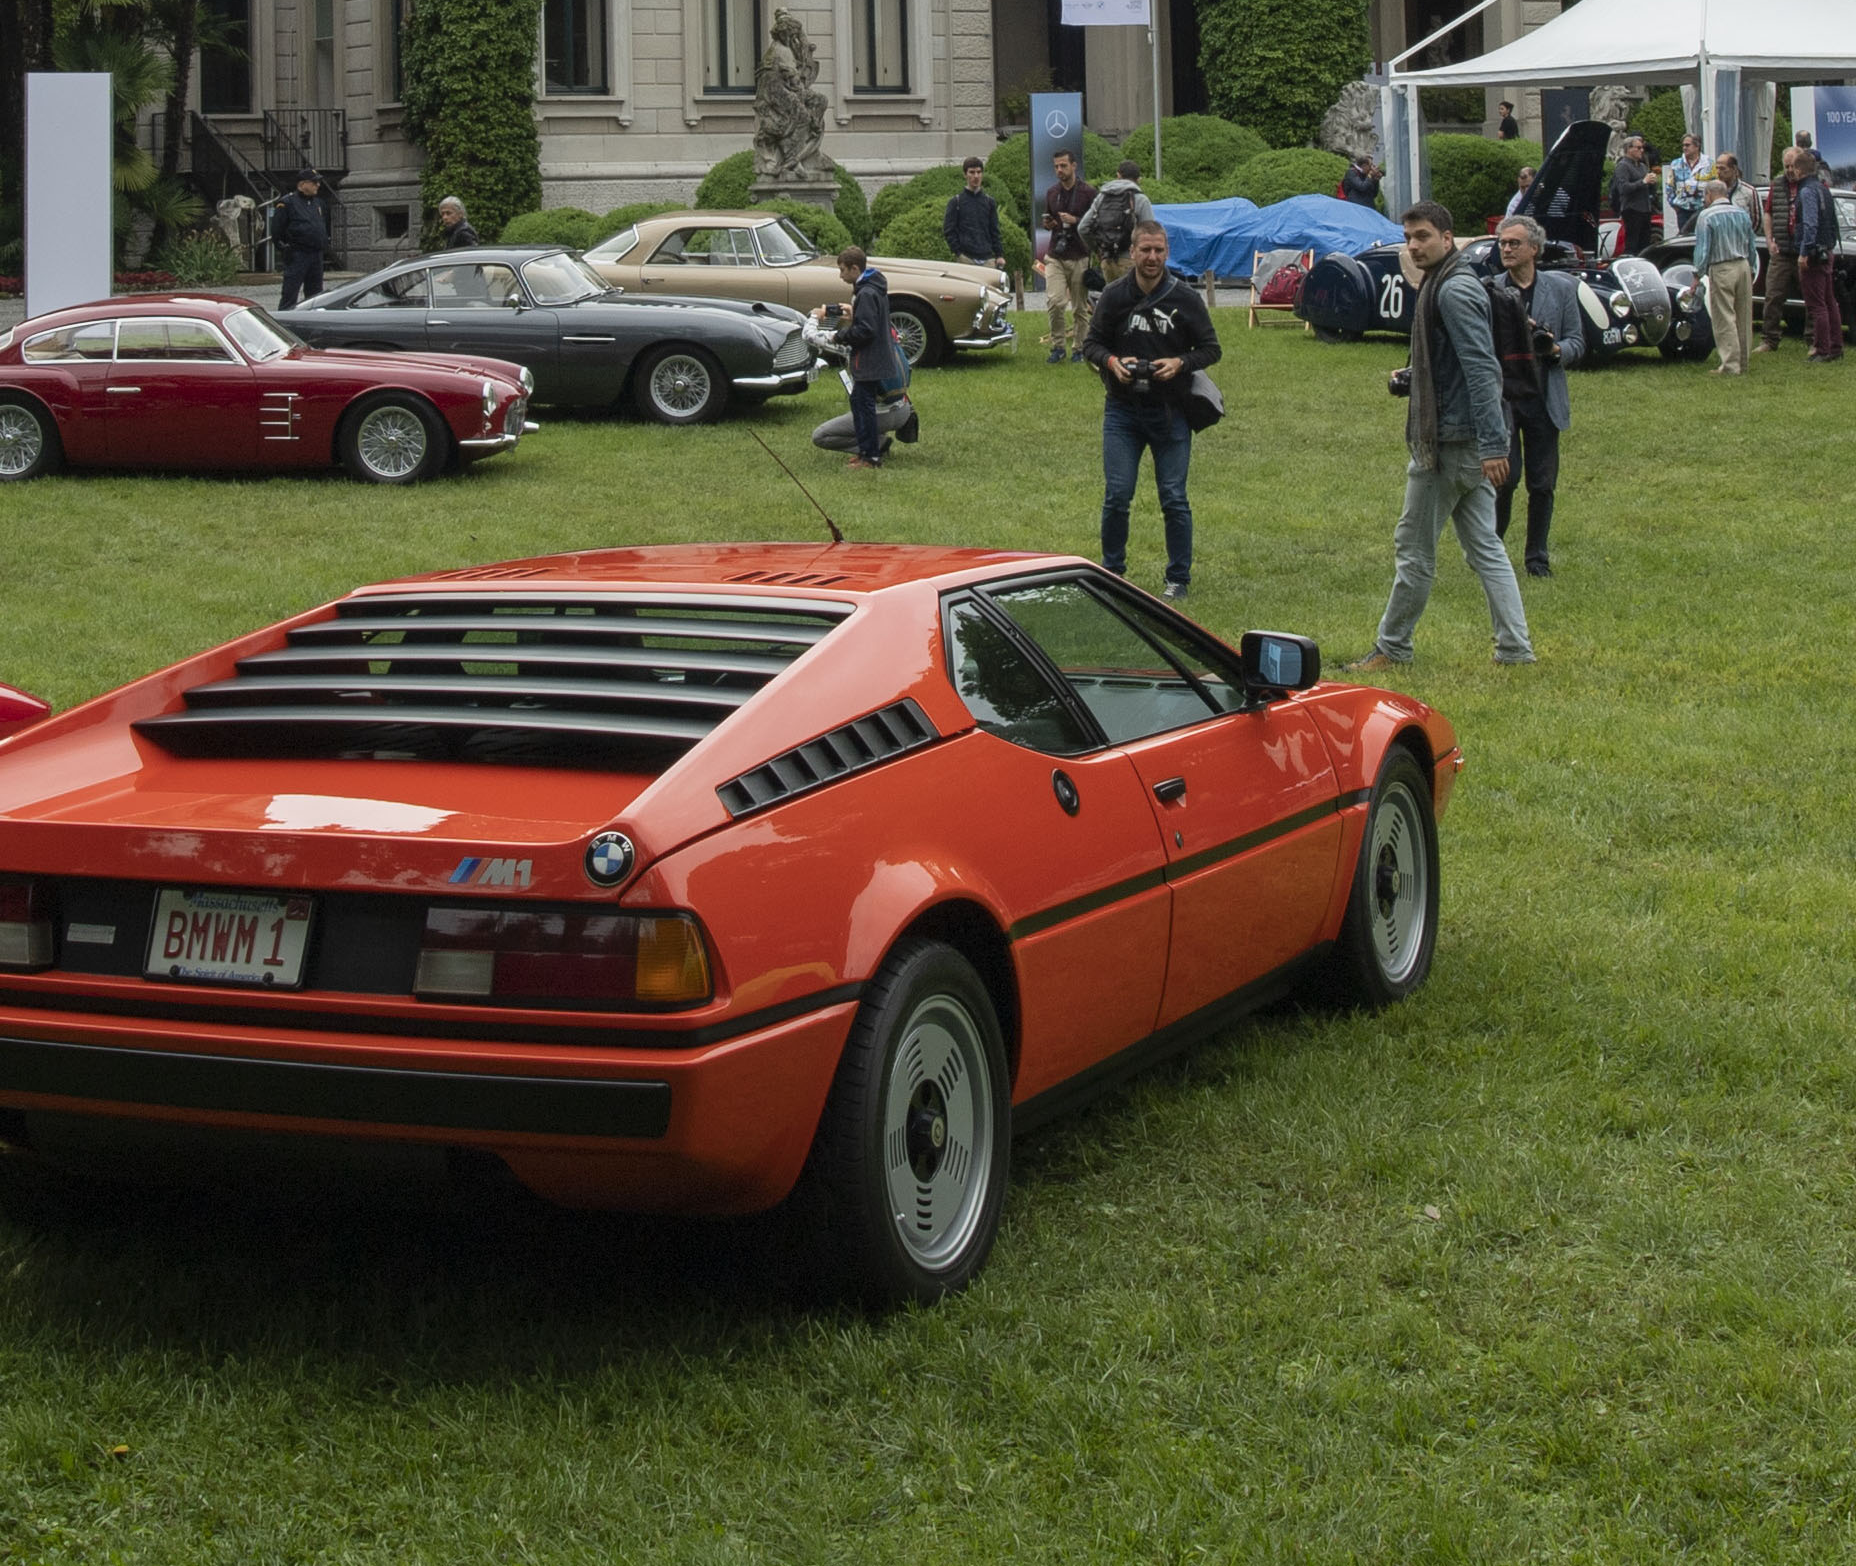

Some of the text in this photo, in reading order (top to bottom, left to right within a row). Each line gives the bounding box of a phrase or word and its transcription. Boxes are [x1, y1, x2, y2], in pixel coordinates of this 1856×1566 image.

[1826, 111, 1841, 123] 100
[1379, 273, 1405, 319] 26
[478, 857, 534, 887] M1
[189, 891, 280, 914] Massachusetts
[163, 910, 260, 964] BMWM
[263, 917, 285, 967] 1
[195, 966, 216, 978] Spirit
[218, 968, 228, 979] of
